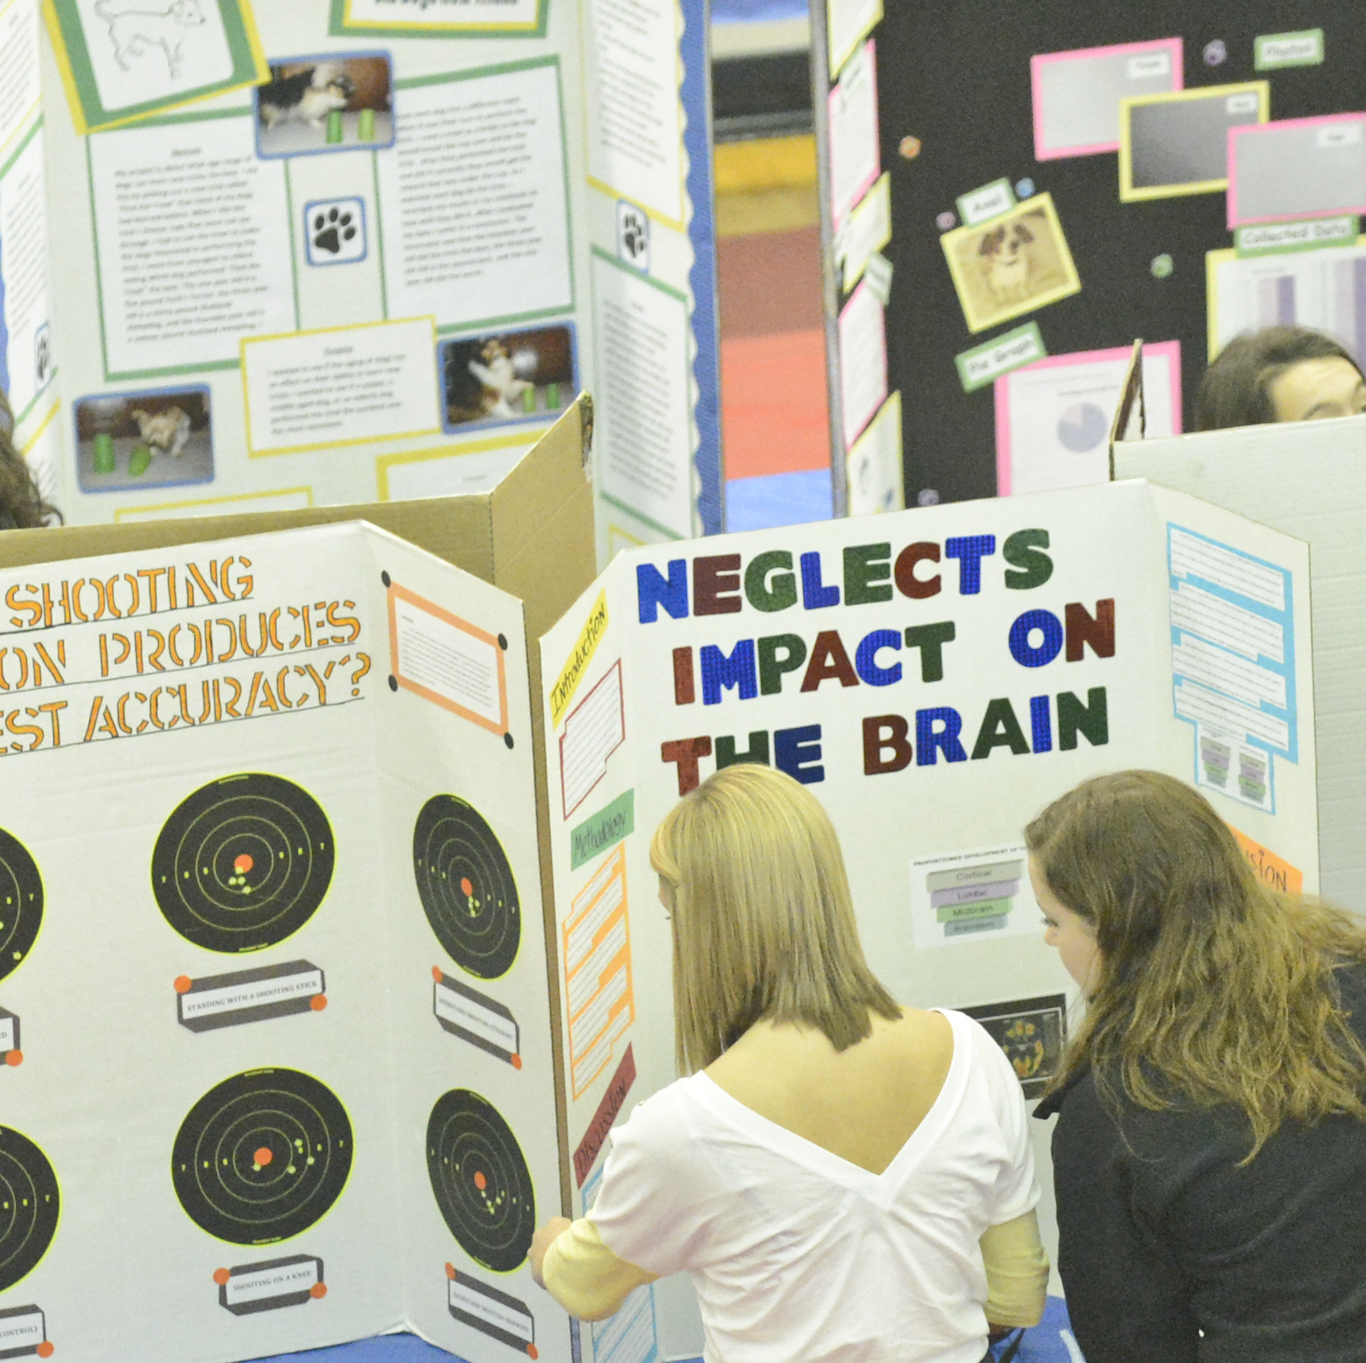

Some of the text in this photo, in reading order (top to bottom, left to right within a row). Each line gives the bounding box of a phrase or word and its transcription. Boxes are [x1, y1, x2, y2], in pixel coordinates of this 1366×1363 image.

[4, 555, 255, 629] SHOOTING
[635, 527, 1055, 624] NEGLECTS
[97, 600, 362, 676] PRODUCES
[552, 602, 606, 719] Introduction
[671, 597, 1116, 706] IMPACT ON
[83, 653, 373, 742] ACCURACY?
[660, 686, 1110, 797] THE BRAIN
[187, 998, 226, 1012] STANDING
[227, 994, 249, 1005] WITH
[256, 985, 295, 999] SHOOTING
[296, 980, 318, 991] STICK
[233, 1279, 273, 1292] SHOOTING
[273, 1276, 284, 1284] ON
[292, 1270, 312, 1280] KNEE
